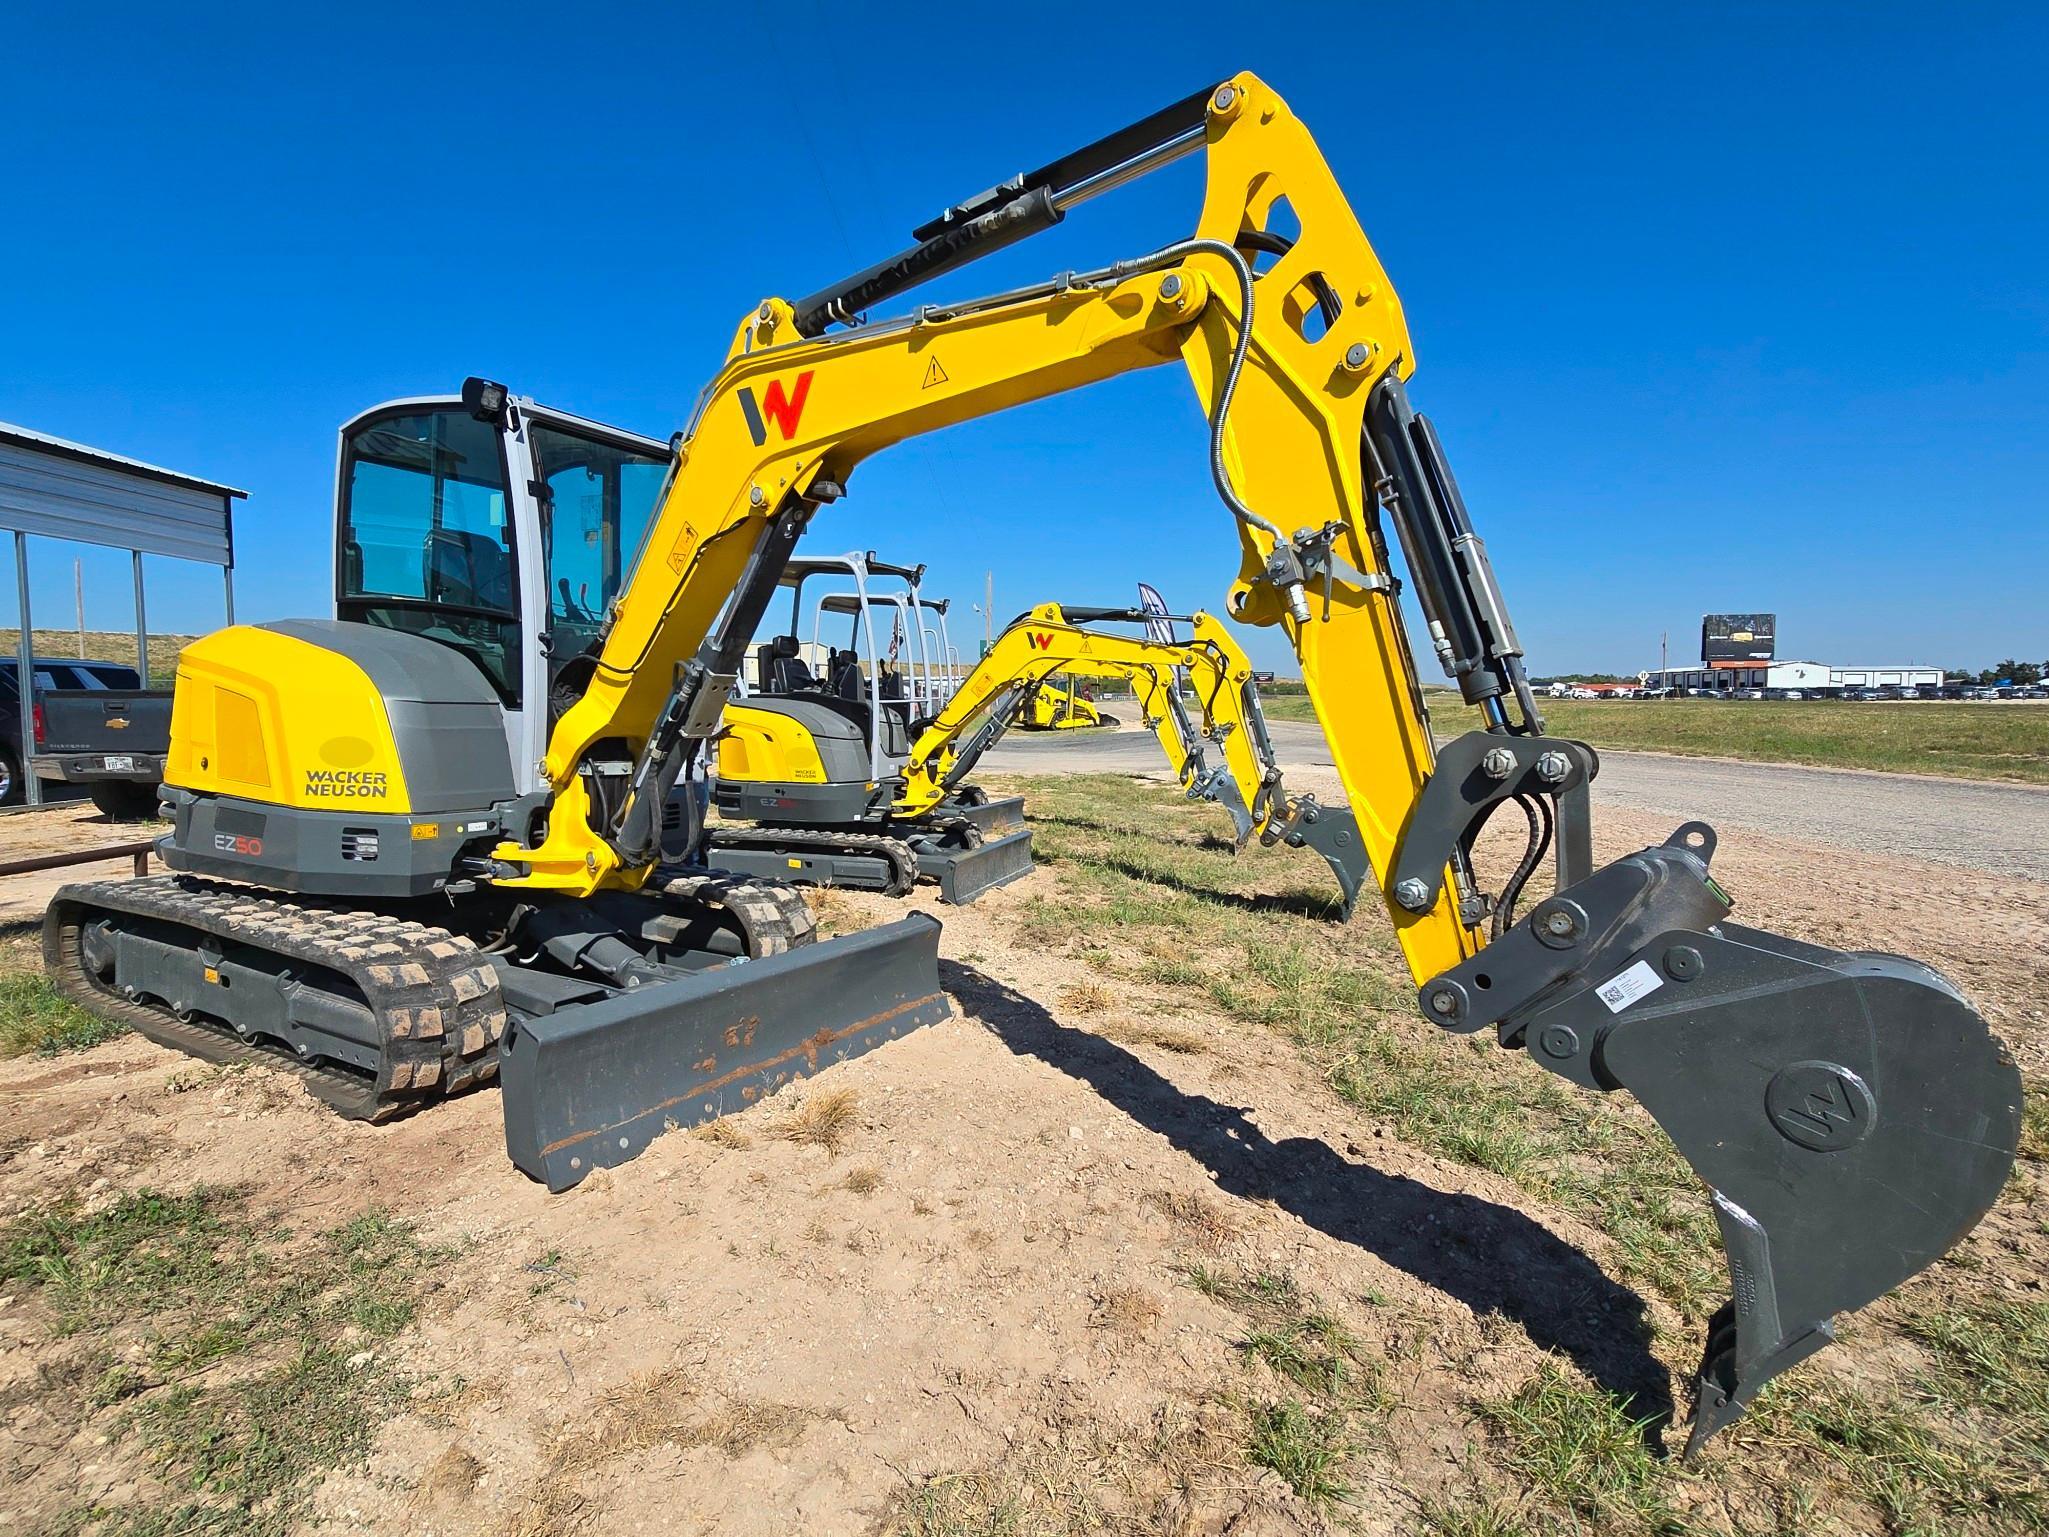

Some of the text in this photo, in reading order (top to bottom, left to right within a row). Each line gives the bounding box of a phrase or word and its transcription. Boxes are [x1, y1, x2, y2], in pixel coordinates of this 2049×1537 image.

[737, 370, 815, 447] W
[306, 770, 387, 785] WACKER
[305, 783, 387, 798] NEUSON
[214, 834, 262, 856] EZ50
